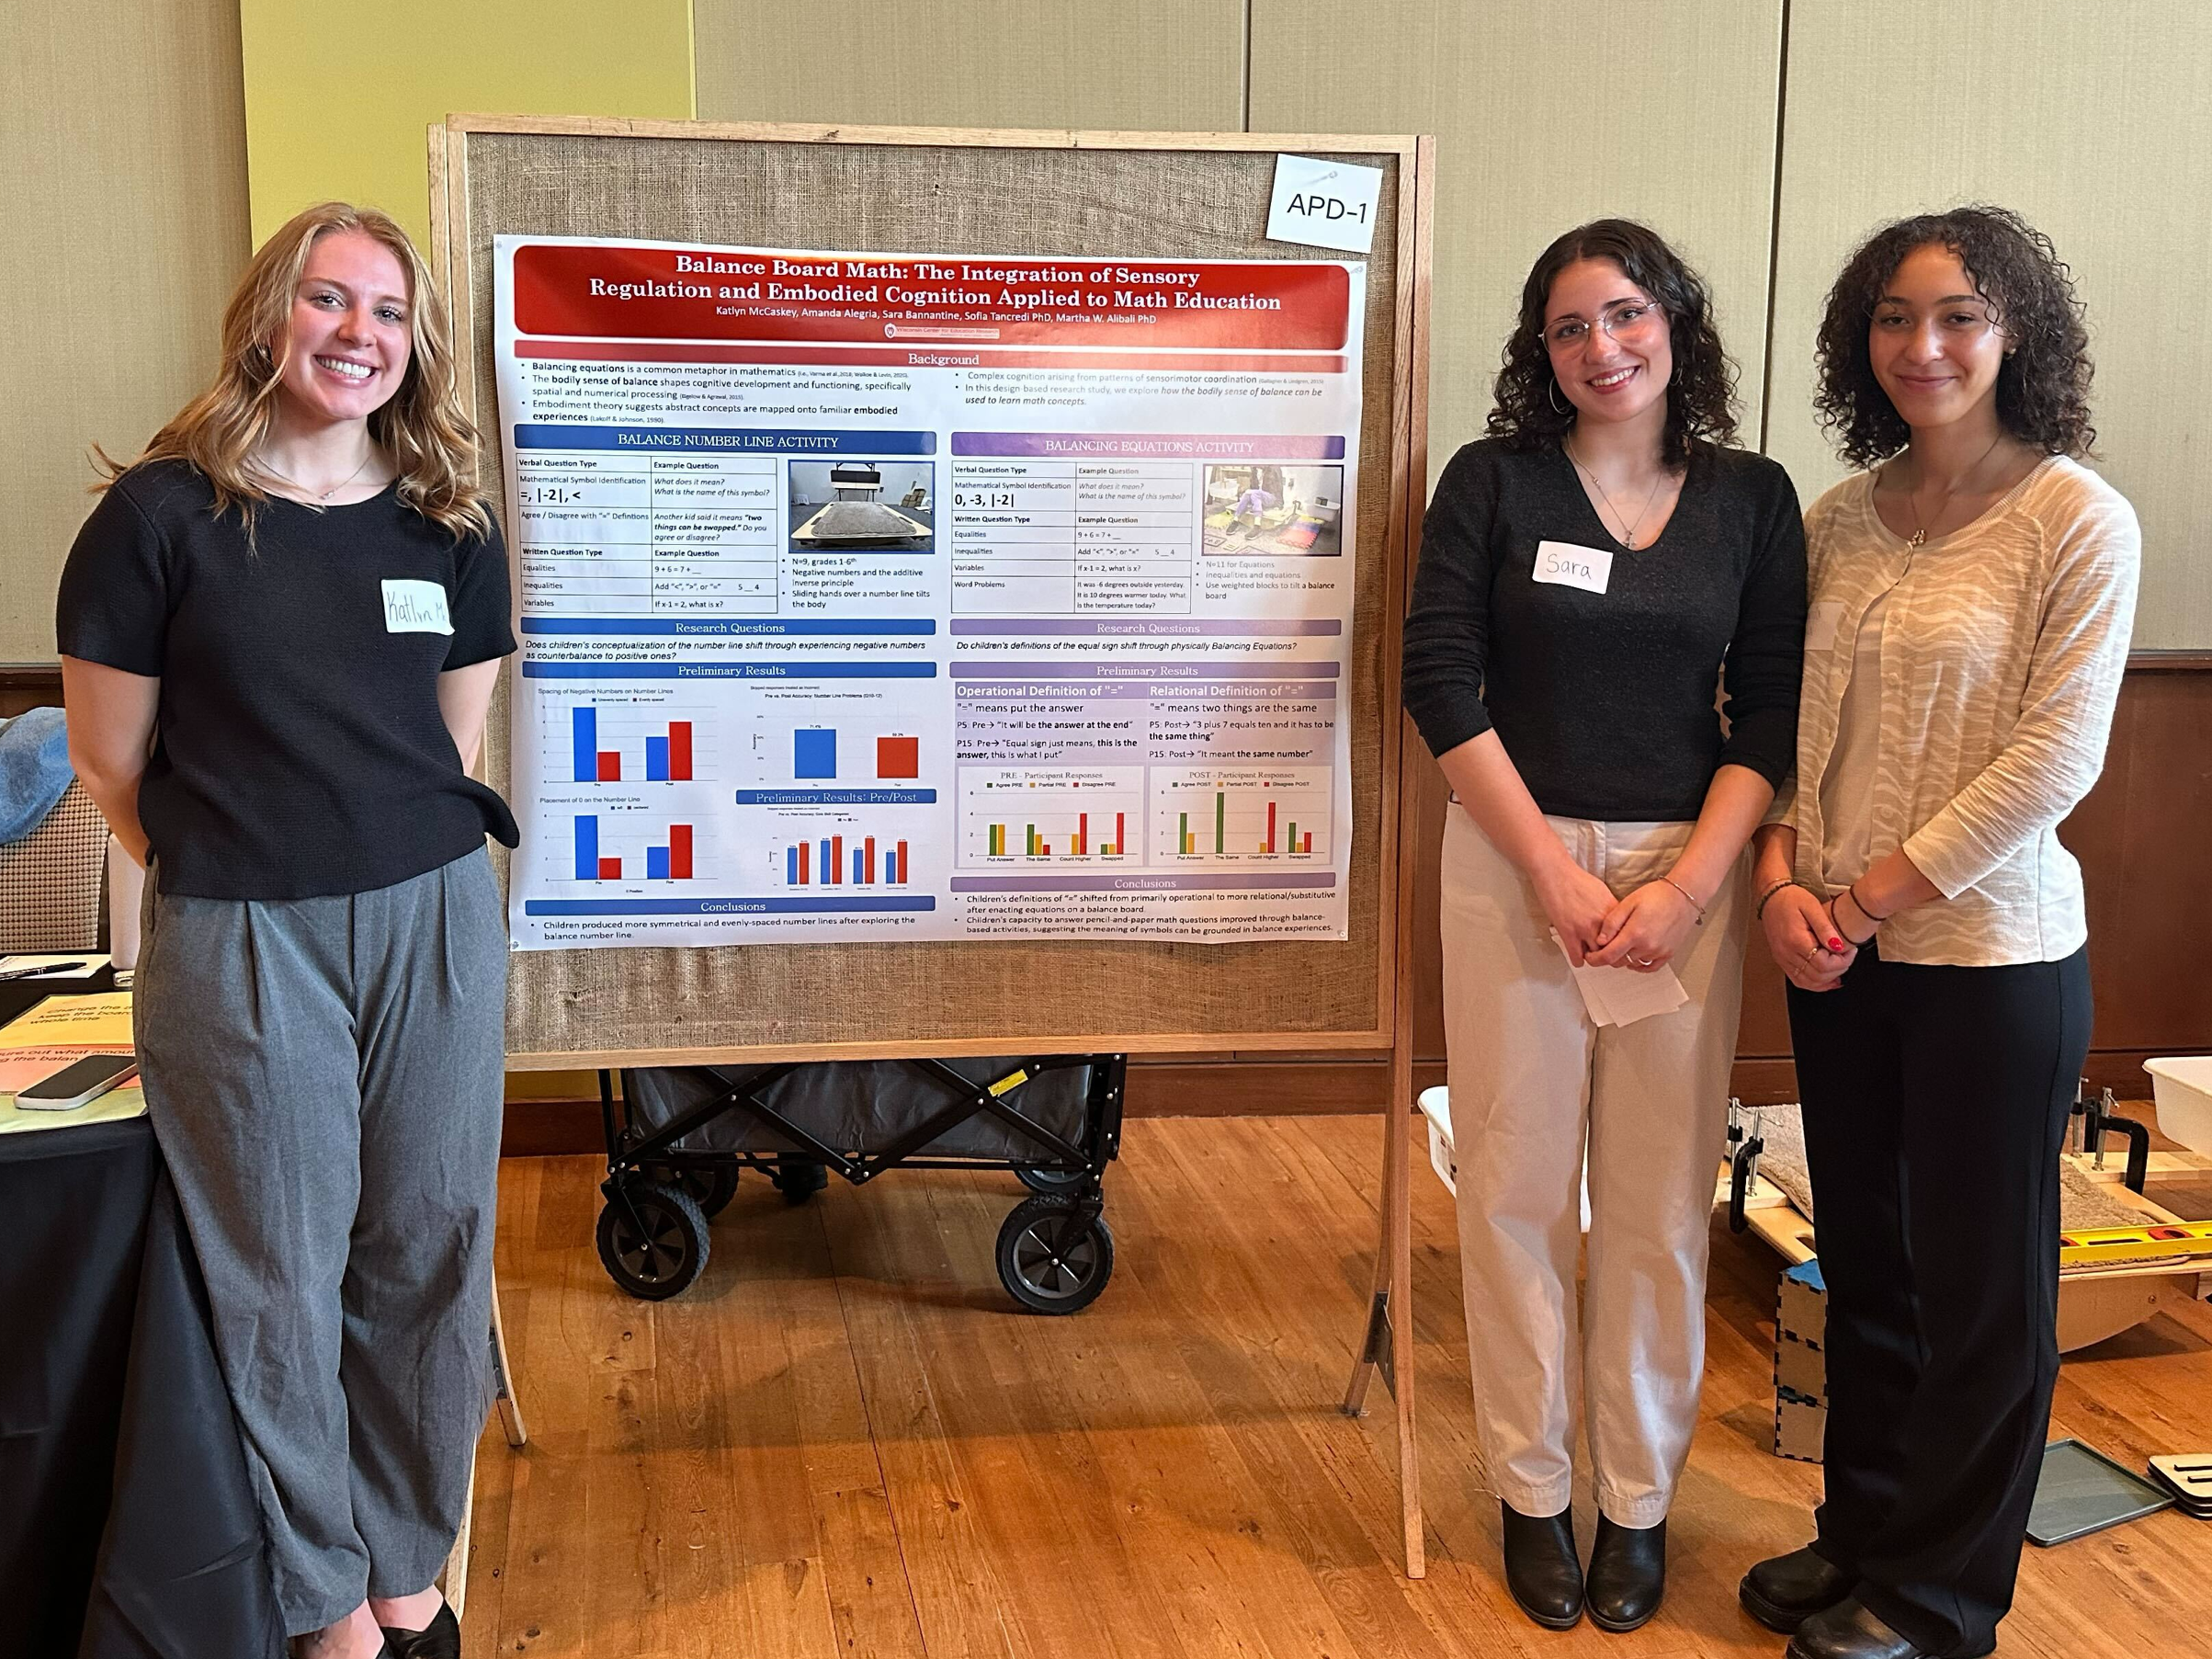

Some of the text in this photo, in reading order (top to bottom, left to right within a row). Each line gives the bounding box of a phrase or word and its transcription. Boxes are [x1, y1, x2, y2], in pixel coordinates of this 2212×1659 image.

[1287, 193, 1367, 224] APD-1
[676, 255, 1199, 288] Balance Board Math: The Integration of Sensory
[590, 278, 1280, 310] Regulation and Embodied Cognition Applied to Math Education
[717, 306, 1156, 326] Katlyn McCaskey, Amanda Alegria, Sara Bannantine, Sofia Tancredi PhD, Martha W. Alibali PhD
[908, 353, 979, 369] Background
[533, 362, 577, 373] Balancing
[579, 364, 624, 373] equations
[685, 366, 726, 376] metaphor
[730, 367, 737, 375] in
[740, 367, 796, 377] mathematics
[532, 374, 549, 382] The
[551, 375, 580, 385] bodily
[611, 376, 620, 384] of
[623, 377, 657, 386] balance
[660, 378, 689, 387] shapes
[693, 380, 731, 388] cognitive
[733, 380, 790, 389] development
[793, 381, 809, 389] and
[811, 380, 862, 391] functioning,
[865, 381, 911, 392] specifically
[965, 395, 985, 403] used
[1023, 396, 1045, 404] math
[533, 399, 590, 409] Embodiment
[594, 401, 623, 411] theory
[625, 403, 663, 412] suggests
[665, 403, 700, 411] abstract
[759, 404, 794, 415] mapped
[820, 404, 851, 414] familiar
[854, 406, 897, 415] embodied
[533, 413, 587, 425] experiences
[618, 433, 837, 448] BALANCE NUMBER LINE ACTIVITY
[1046, 440, 1253, 453] BALANCING EQUATIONS ACTIVITY
[1547, 553, 1591, 580] Sara
[792, 589, 817, 598] Sliding
[676, 622, 785, 633] Research Questions
[1097, 623, 1199, 634] Research Questions
[678, 665, 785, 676] Preliminary Results
[1097, 665, 1197, 676] Preliminary Results
[957, 686, 1026, 698] Operational
[1029, 685, 1086, 696] Definition
[1090, 685, 1101, 696] of
[1151, 685, 1207, 696] Relational
[1210, 685, 1266, 696] Definition
[1270, 685, 1282, 696] of
[1011, 705, 1027, 714] put
[1029, 703, 1045, 712] the
[1202, 704, 1220, 712] two
[1223, 703, 1252, 714] things
[1273, 703, 1288, 712] the
[756, 792, 915, 806] Preliminary Results: Pre/Post
[1115, 879, 1175, 888] Conclusions
[700, 902, 766, 911] Conclusions
[582, 921, 622, 930] produced
[650, 919, 700, 928] symmetrical
[721, 918, 780, 926] evenly-spaced
[861, 916, 899, 925] exploring
